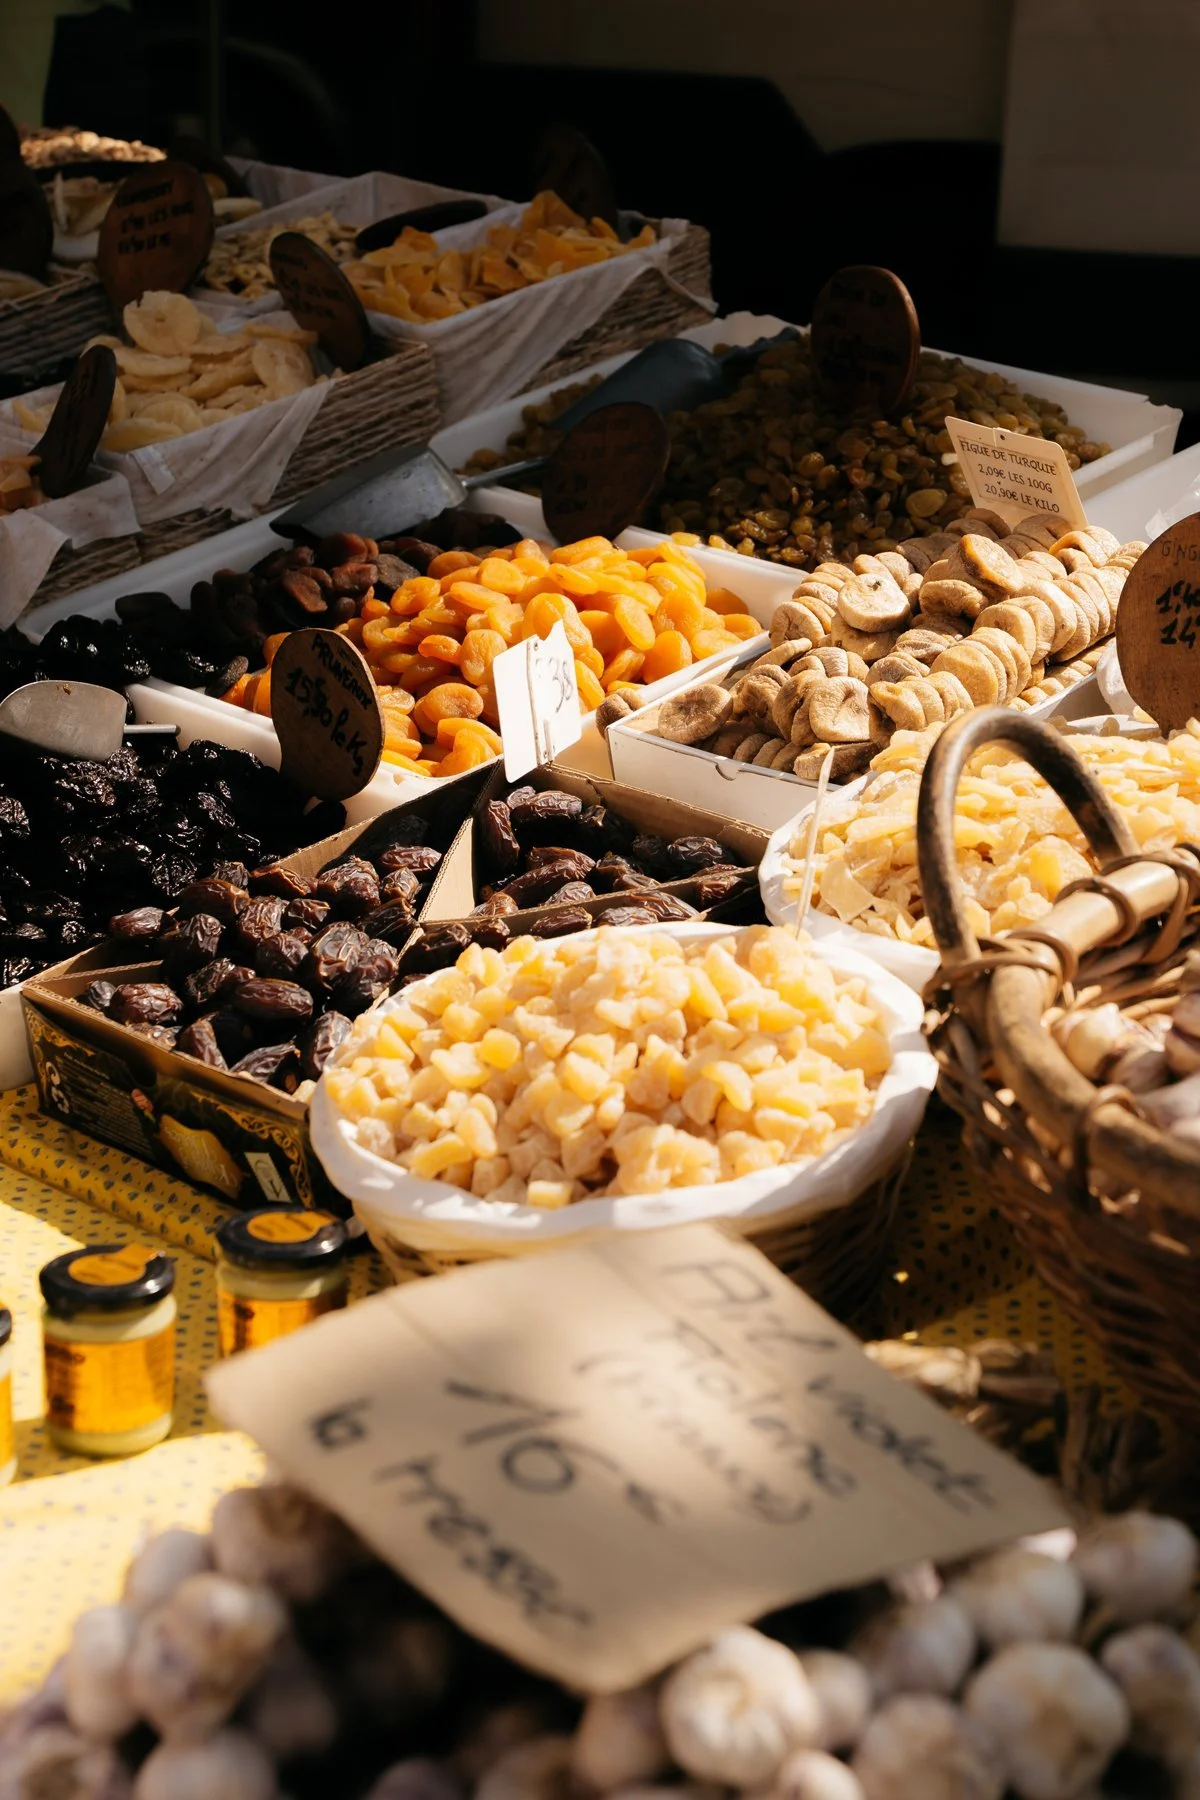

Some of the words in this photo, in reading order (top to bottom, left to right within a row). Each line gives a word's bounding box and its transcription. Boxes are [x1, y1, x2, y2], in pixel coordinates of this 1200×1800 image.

[960, 440, 990, 457] FIGUE
[992, 449, 1007, 461] DE
[1008, 453, 1056, 476] TURQUIE
[978, 463, 1006, 479] 2,09€
[1008, 471, 1025, 485] LES
[1027, 477, 1053, 494] 100G
[984, 483, 1019, 501] 20,90€
[1020, 493, 1033, 506] LE
[1034, 497, 1060, 513] KILO
[312, 632, 372, 710] PRUNEAUX
